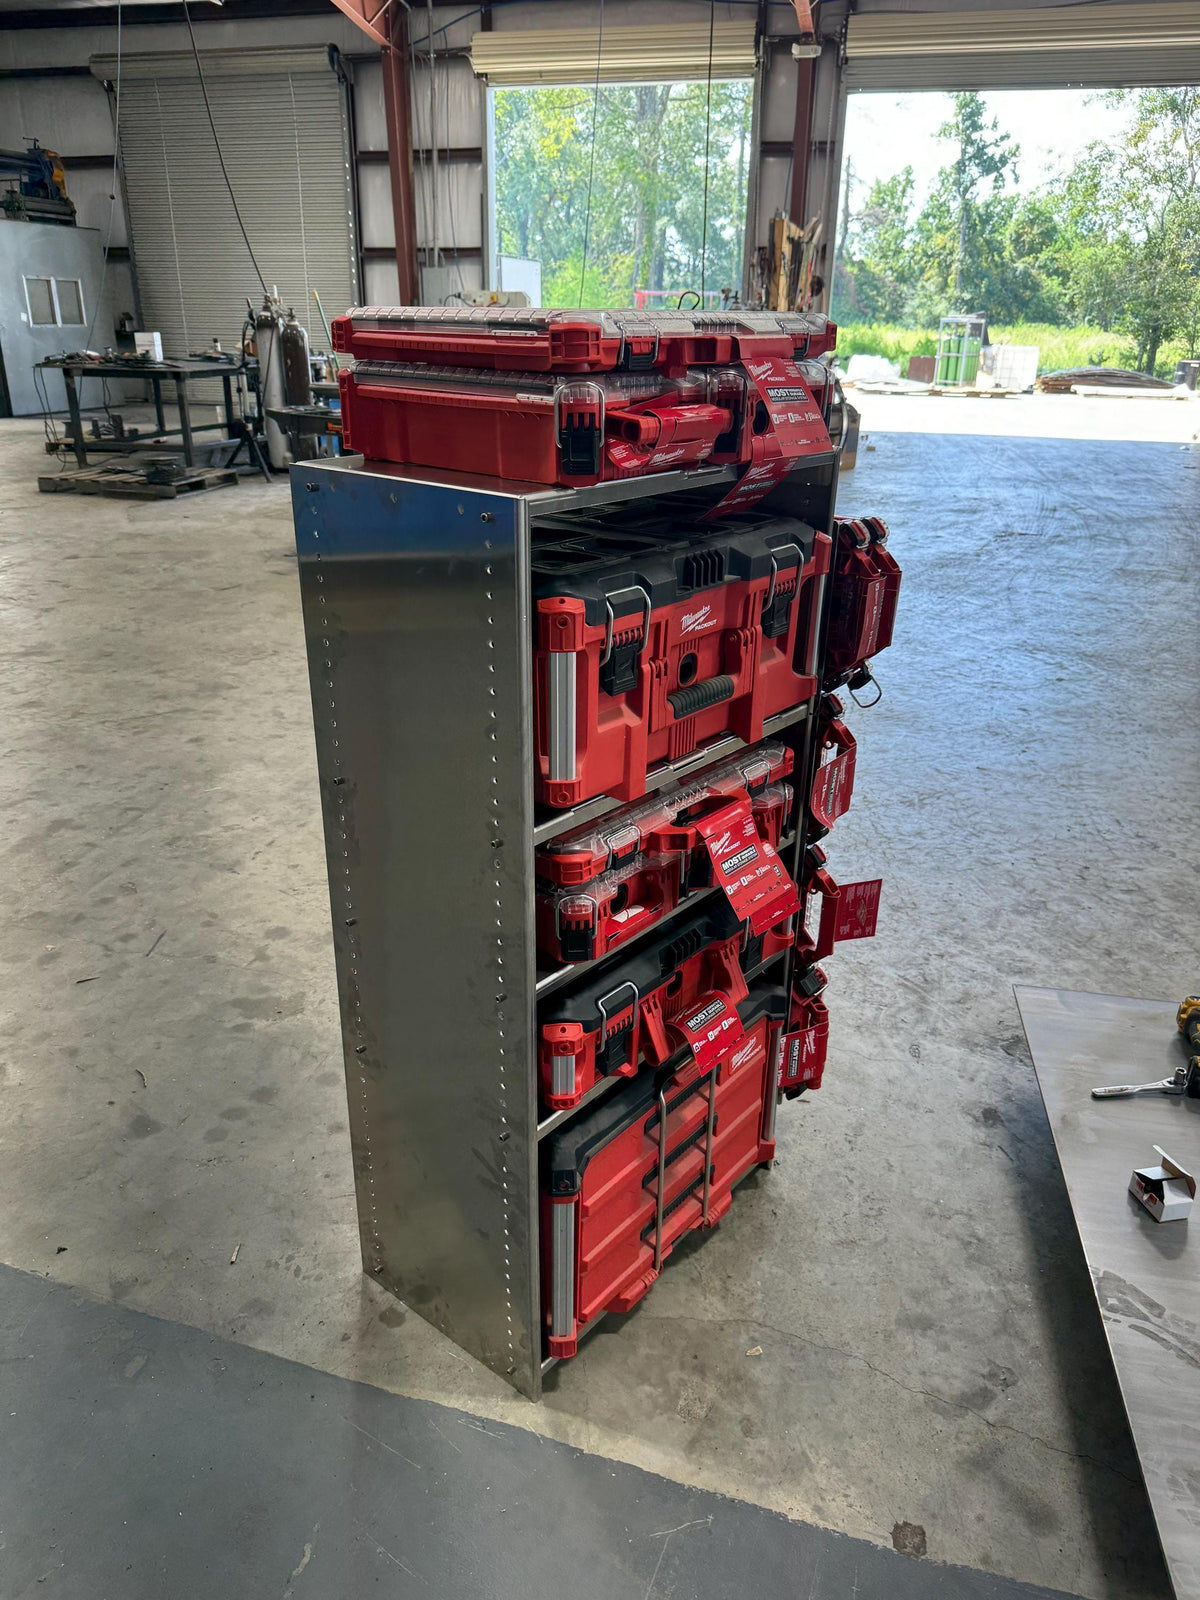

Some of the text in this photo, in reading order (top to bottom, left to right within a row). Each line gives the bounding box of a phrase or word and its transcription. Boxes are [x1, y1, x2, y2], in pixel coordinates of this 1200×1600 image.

[767, 388, 789, 397] MOST
[681, 605, 710, 631] Milwaukee
[695, 619, 717, 631] PACKOUT
[722, 854, 742, 871] MOST
[687, 1010, 709, 1029] MOST
